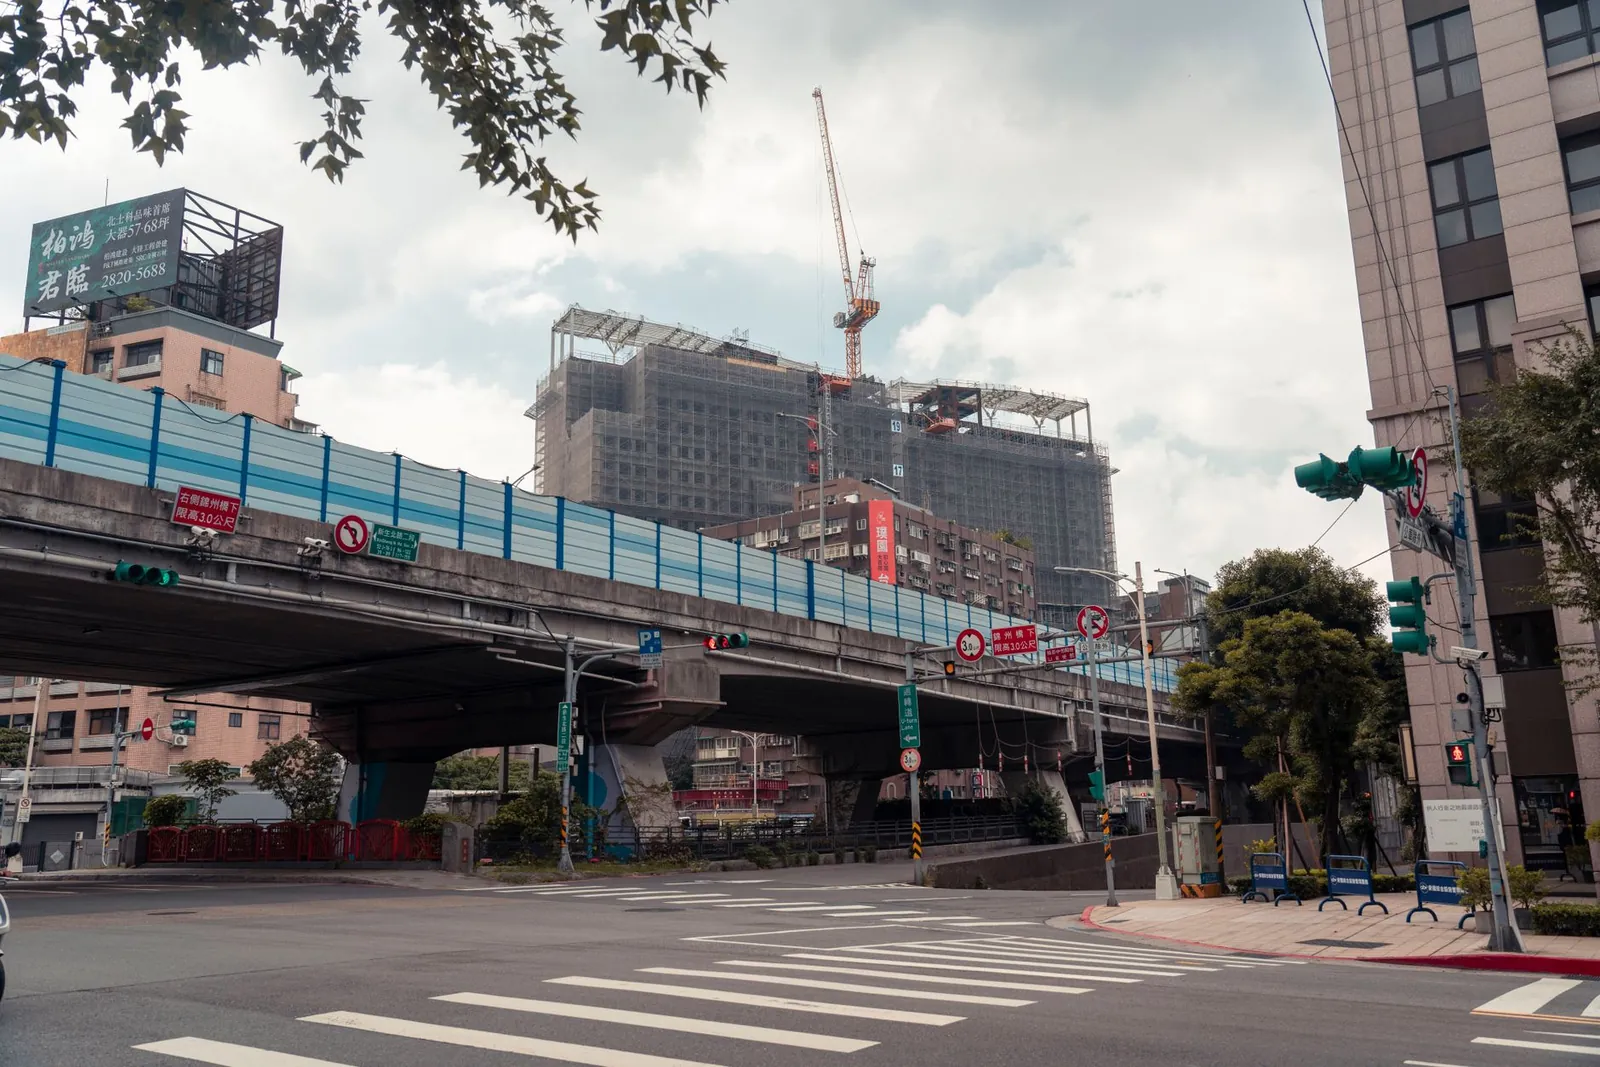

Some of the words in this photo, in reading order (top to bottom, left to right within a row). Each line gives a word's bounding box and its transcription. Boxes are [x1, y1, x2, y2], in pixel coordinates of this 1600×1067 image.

[106, 202, 171, 227] 北士科品味首席
[101, 262, 166, 288] 2820-5688
[37, 264, 91, 303] 君臨
[892, 421, 901, 431] 19
[894, 465, 902, 476] 17
[180, 492, 239, 513] 右側錦州橋下
[176, 507, 235, 529] 限高3.0公尺
[640, 632, 651, 646] P
[993, 628, 1035, 641] 錦州橋下
[962, 641, 972, 651] 3.0
[994, 640, 1036, 653] 限高3.0公尺
